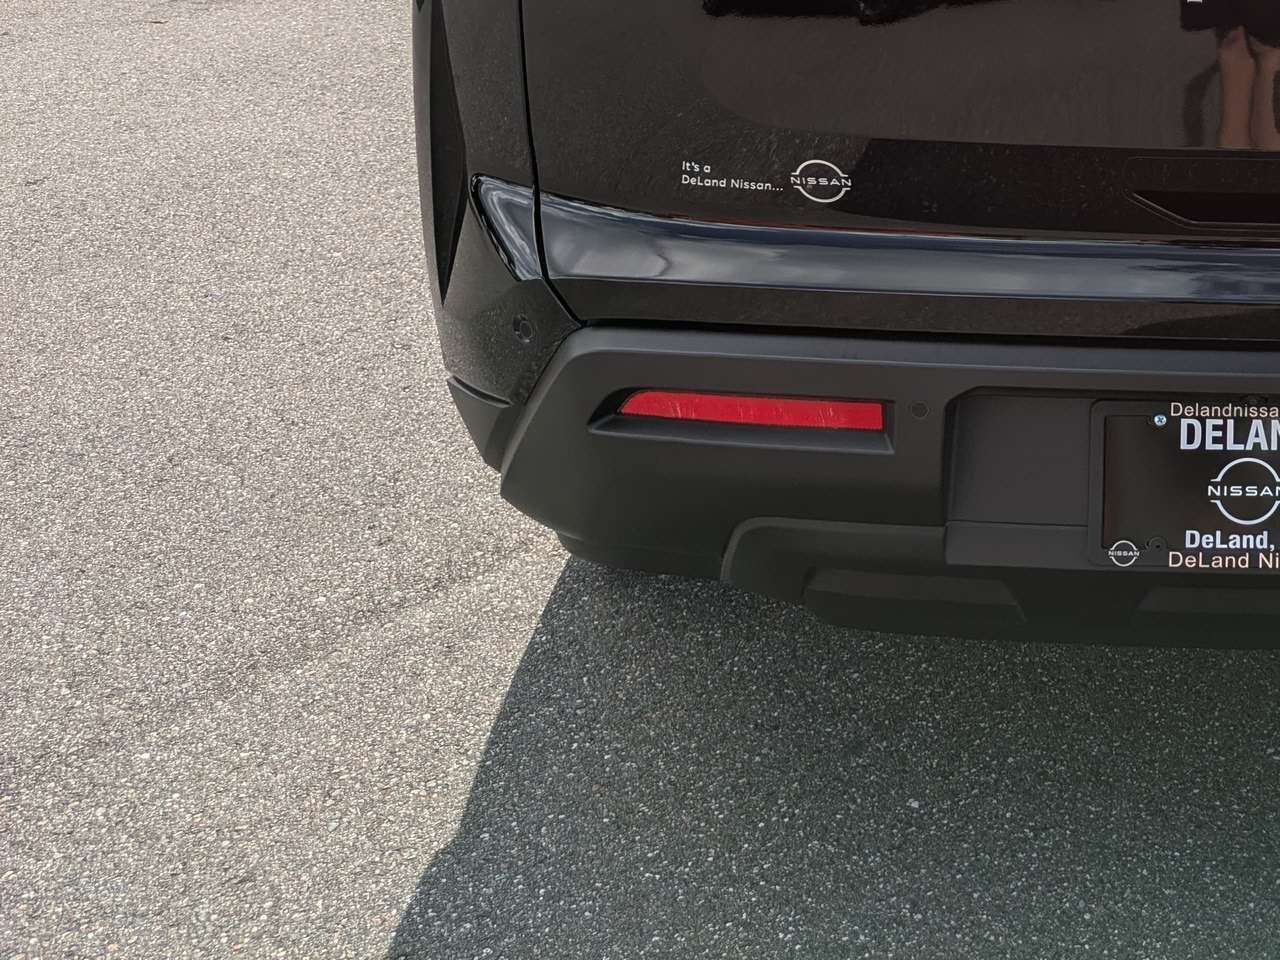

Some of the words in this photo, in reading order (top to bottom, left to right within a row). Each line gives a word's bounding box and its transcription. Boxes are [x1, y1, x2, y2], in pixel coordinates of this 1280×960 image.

[682, 161, 700, 172] It's
[703, 165, 711, 173] a
[681, 174, 727, 188] DeLand
[730, 178, 784, 191] Nissan...
[790, 176, 852, 187] NISSAN
[1185, 530, 1275, 552] DeLand,
[1168, 551, 1249, 569] DeLand
